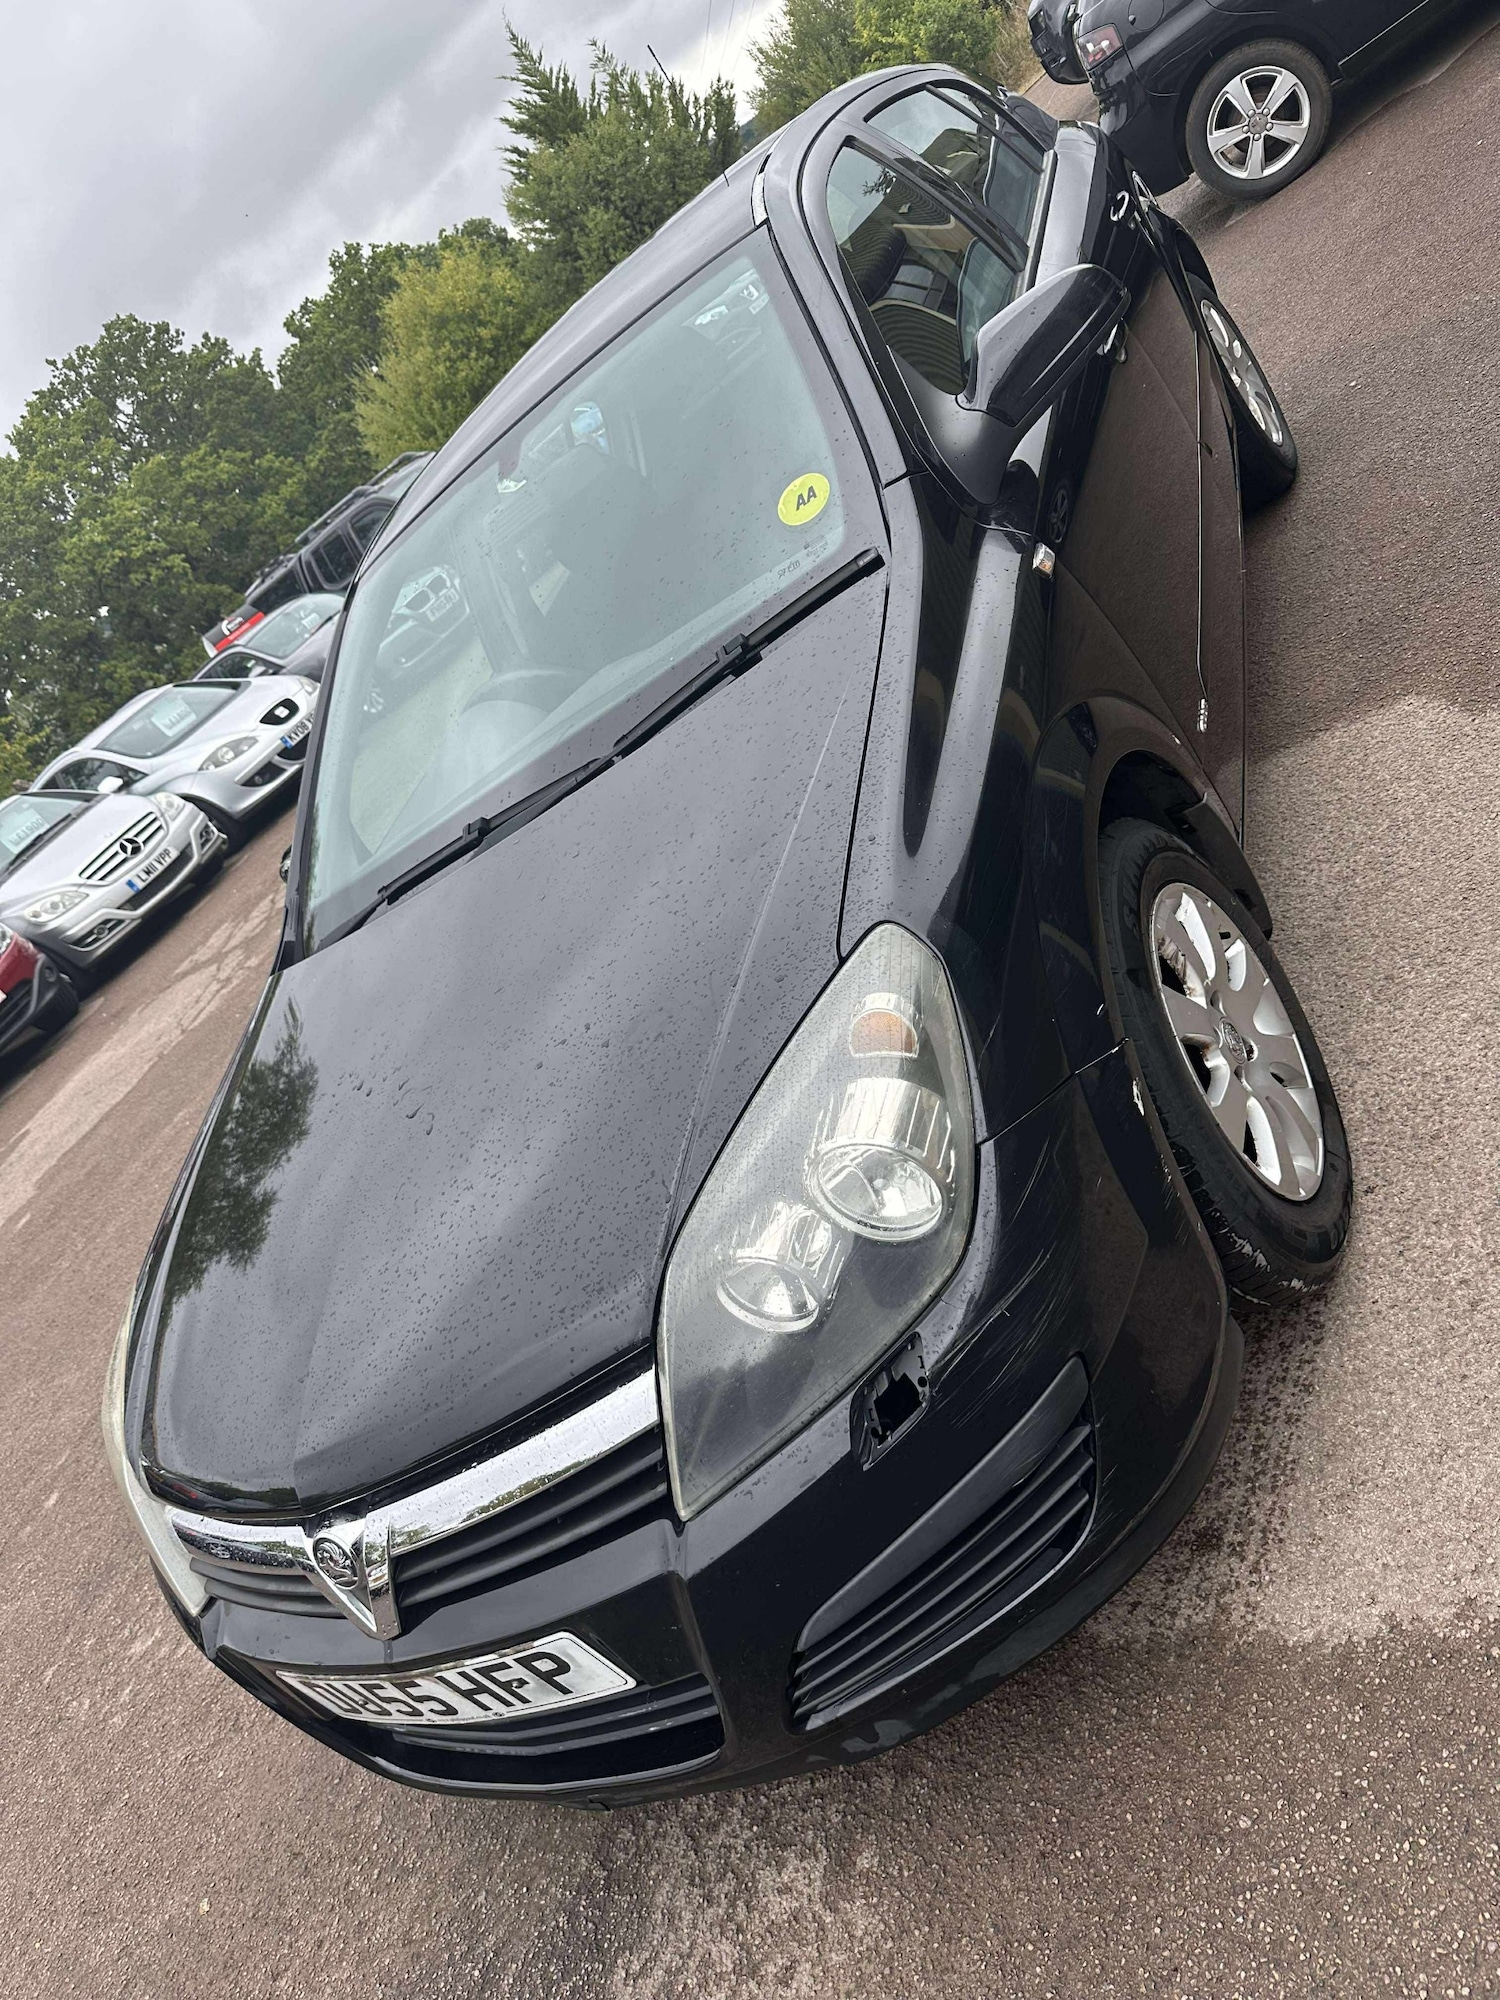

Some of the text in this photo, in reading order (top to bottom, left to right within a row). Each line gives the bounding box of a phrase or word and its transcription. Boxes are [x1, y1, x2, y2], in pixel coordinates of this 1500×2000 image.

[796, 485, 817, 511] AA
[286, 720, 310, 743] KV08
[136, 847, 172, 883] LM11 VPP
[298, 1651, 574, 1716] DU55 HFP
